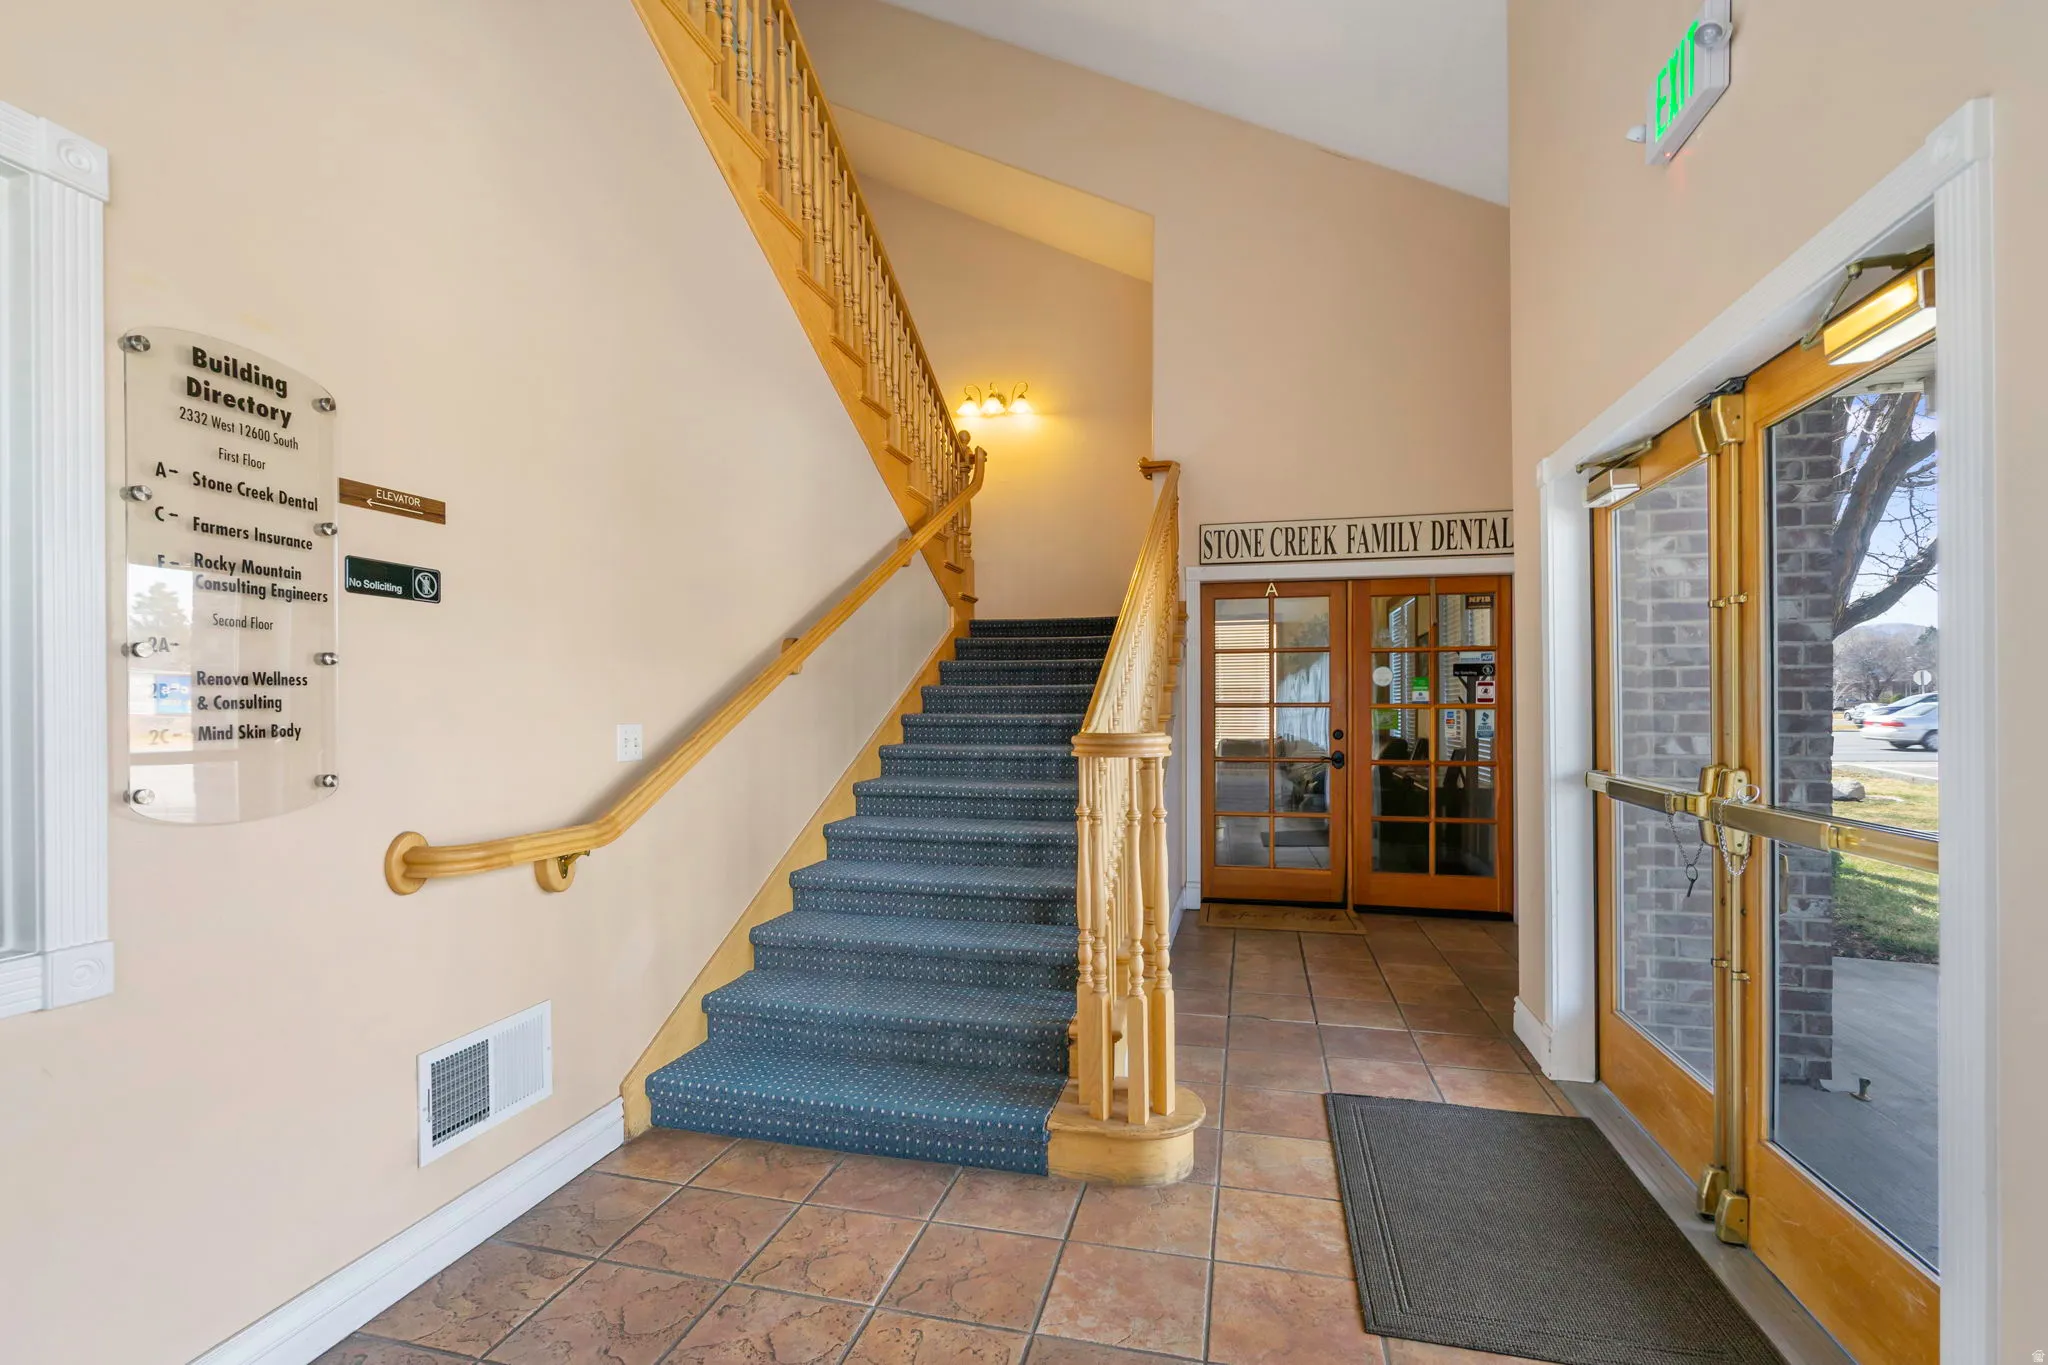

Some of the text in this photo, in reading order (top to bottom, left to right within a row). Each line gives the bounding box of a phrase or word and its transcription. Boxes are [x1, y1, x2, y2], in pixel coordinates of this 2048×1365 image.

[1655, 20, 1698, 142] EXIT
[192, 346, 287, 398] Building
[186, 375, 292, 428] Directory
[179, 406, 299, 450] 2332 West 12600 South
[218, 447, 266, 470] First Floor
[192, 471, 232, 493] Stone
[237, 482, 274, 502] Creek
[279, 490, 318, 511] Dental
[376, 489, 421, 507] ELEVATOR
[193, 516, 249, 540] Farmers
[254, 527, 313, 550] Insurance
[1203, 517, 1514, 559] STONE CREEK FAMILY DENTAL
[194, 552, 236, 576] Rocky
[241, 559, 302, 581] Mountain
[195, 574, 328, 603] Consulting Engineers
[349, 577, 403, 594] No Soliciting
[1265, 582, 1279, 597] A
[212, 613, 274, 631] Second Floor
[197, 670, 308, 686] Renova Wellness
[197, 694, 282, 712] & Consulting
[198, 724, 233, 741] Mind
[238, 724, 266, 740] Skin
[271, 724, 301, 741] Body
